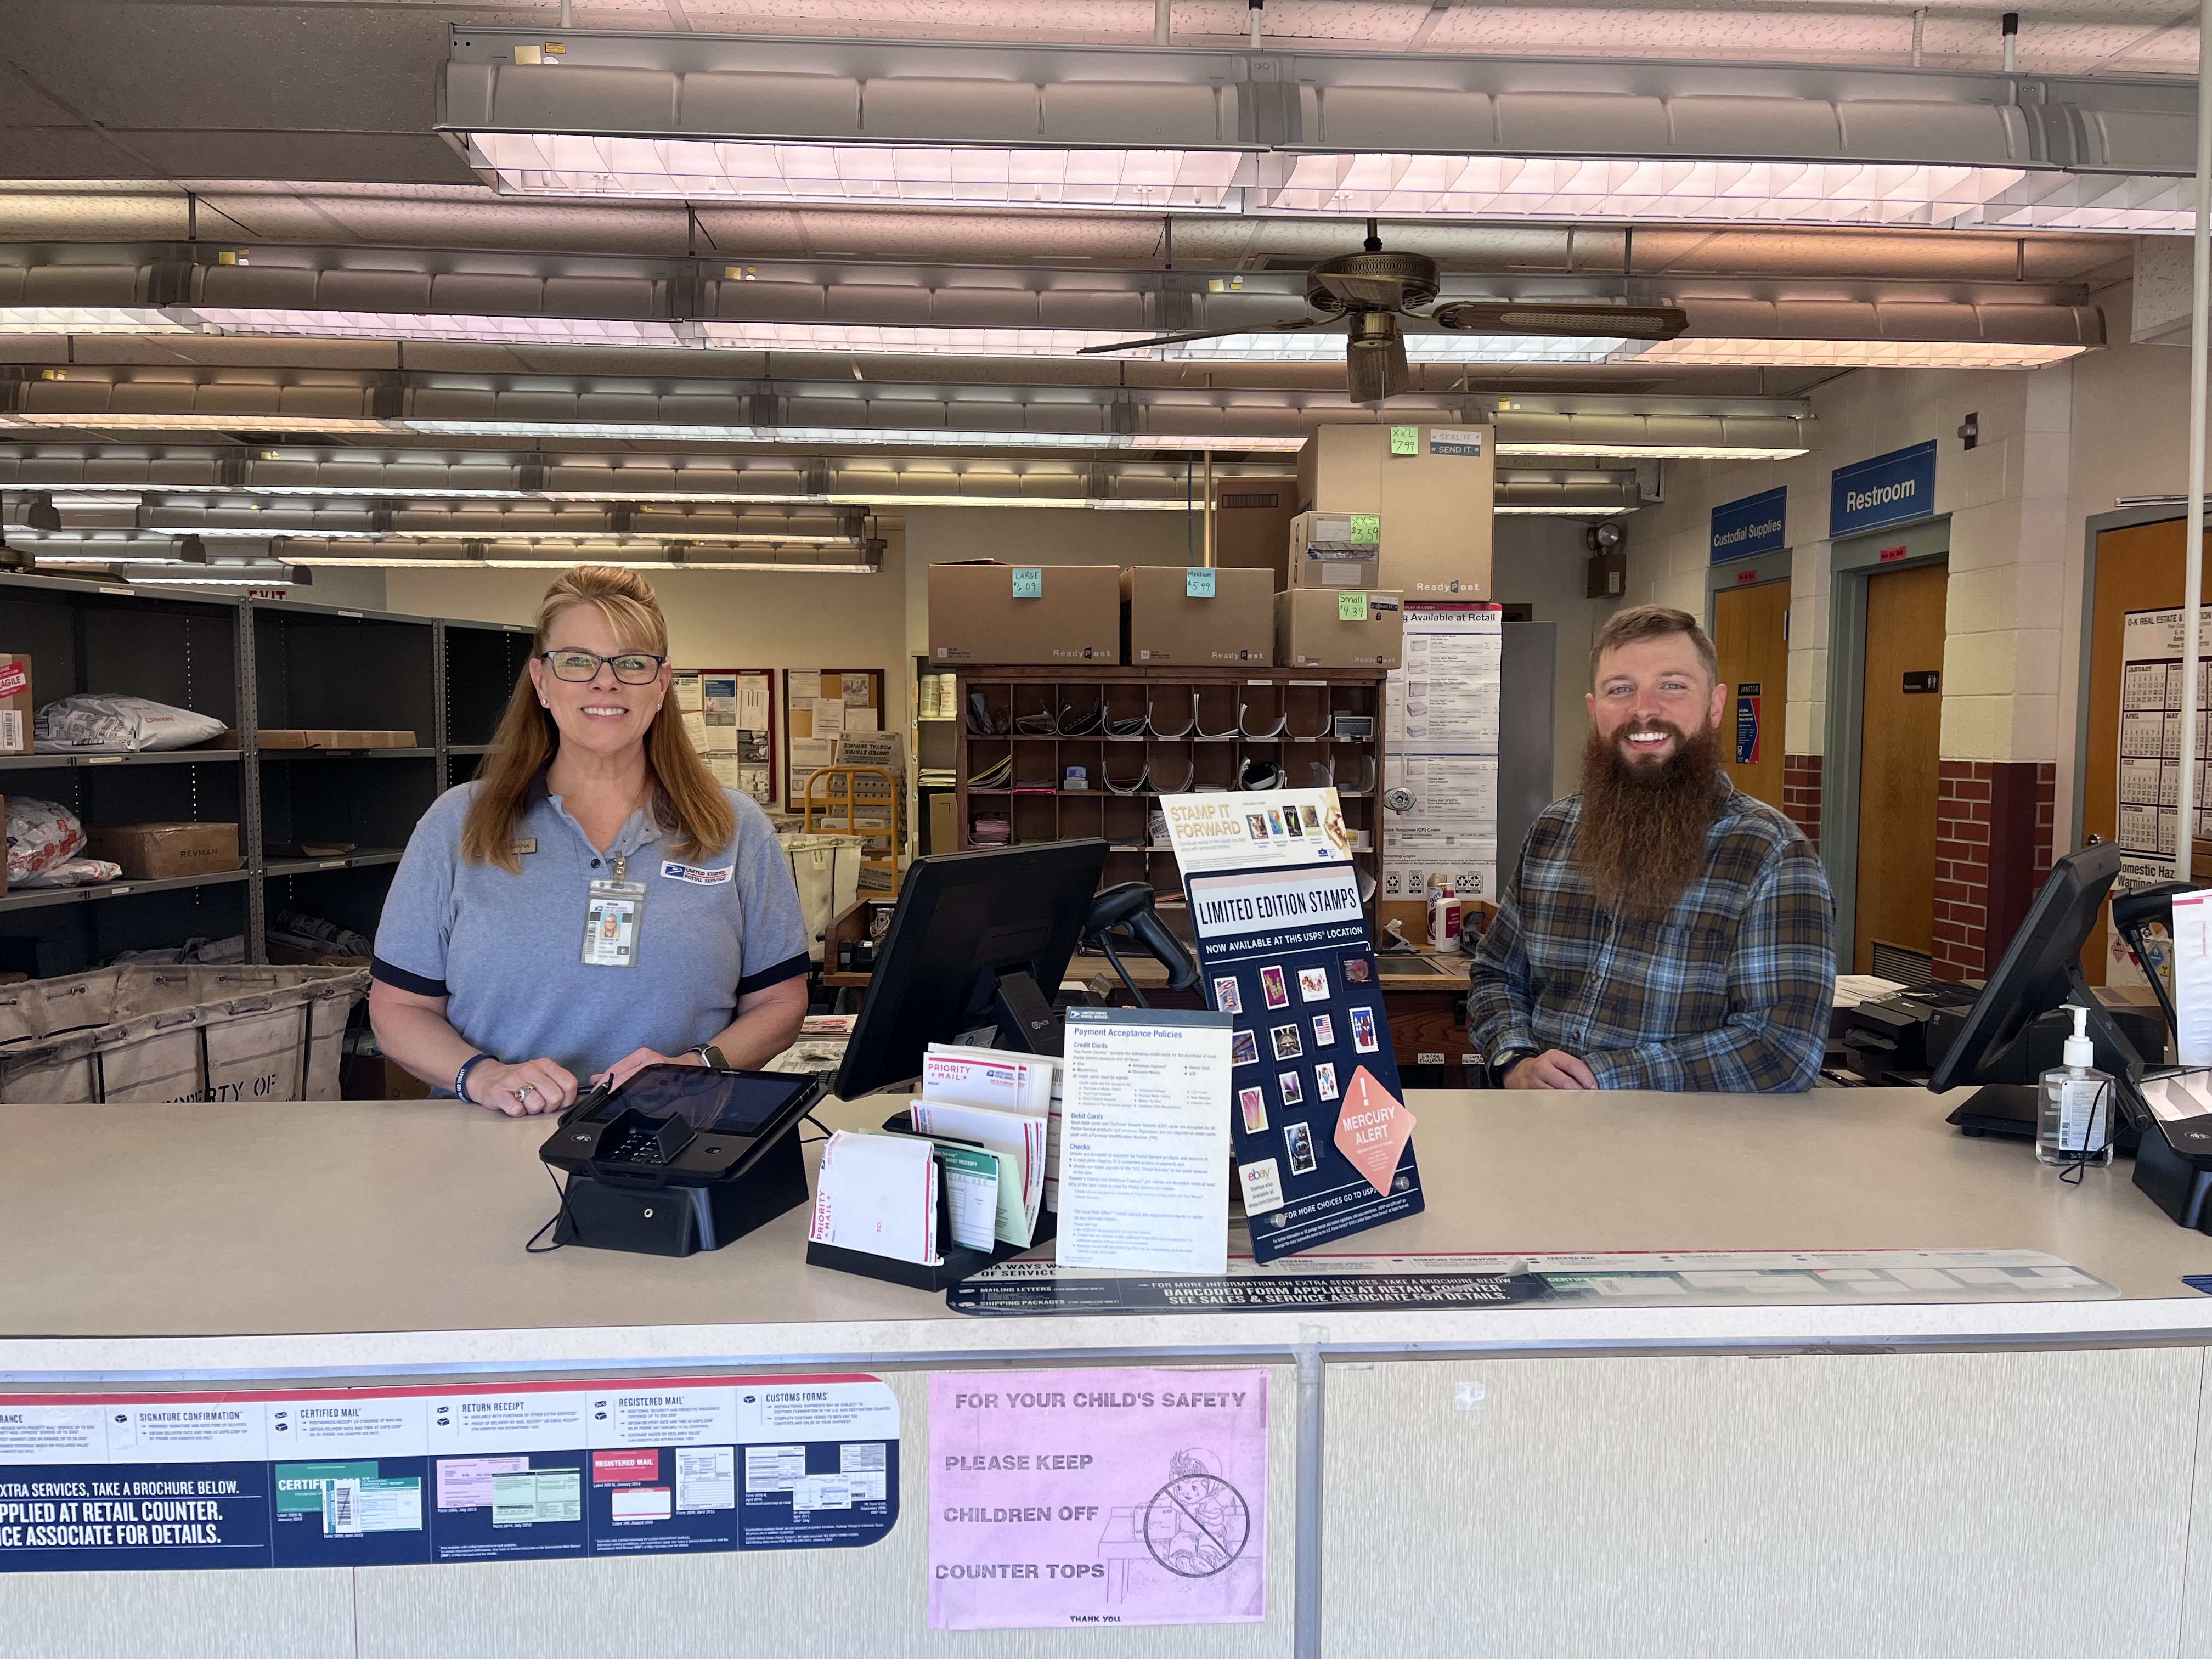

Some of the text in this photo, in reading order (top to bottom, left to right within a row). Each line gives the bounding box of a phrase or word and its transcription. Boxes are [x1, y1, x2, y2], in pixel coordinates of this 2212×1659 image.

[1392, 429, 1415, 438] XXL
[1846, 479, 1915, 513] Restroom
[1352, 516, 1377, 526] XXS
[1351, 526, 1378, 541] $3.59
[1713, 519, 1782, 548] Custodial Supplies
[1417, 580, 1481, 594] ReadyPost
[1340, 594, 1362, 603] Small
[1411, 613, 1453, 622] Available
[1468, 613, 1496, 622] Retail
[2157, 614, 2177, 623] ESTATE
[1053, 647, 1111, 659] ReadyPost
[1211, 649, 1265, 661] ReadyPost
[1355, 655, 1396, 664] ReadyPost
[0, 676, 21, 689] AGILE
[1170, 804, 1229, 821] STAMP IT
[1174, 821, 1241, 838] FORWARD
[180, 849, 218, 858] REVMAN
[685, 867, 705, 876] UNITED
[2121, 864, 2175, 879] omestic Haz
[1198, 888, 1356, 925] LIMITED EDITION STAMPS
[1206, 943, 1227, 955] NOW
[1229, 937, 1272, 951] AVAILABLE
[1274, 936, 1283, 946] AT
[1285, 933, 1302, 944] THIS
[1327, 926, 1363, 939] LOCATION
[1039, 1019, 1051, 1028] NCR
[1075, 1028, 1182, 1039] Payment Acceptance Policies
[928, 1064, 971, 1074] PRIORITY
[1342, 1105, 1396, 1132] MERCURY
[1356, 1125, 1388, 1146] ALERT
[1248, 1168, 1271, 1182] ebay
[1248, 1195, 1281, 1209] ebay.com/stamps
[1252, 1191, 1269, 1199] available
[1284, 1187, 1379, 1220] FOR MORE CHOICES GO TO USPS.
[816, 1190, 826, 1240] PRIORITY
[1163, 1288, 1243, 1296] BARCODED
[1293, 1286, 1355, 1294] APPLIED
[1358, 1286, 1375, 1294] AT
[1379, 1285, 1428, 1294] RETAIL
[1431, 1284, 1506, 1293] COUNTER.
[1169, 1296, 1197, 1305] SEE
[1200, 1295, 1246, 1304] SALES
[1266, 1294, 1329, 1303] SERVICE
[1331, 1293, 1413, 1302] ASSOCIATE
[1414, 1293, 1443, 1301] FOR
[1444, 1291, 1510, 1301] DETAILS.
[462, 1402, 524, 1413] RETURN RECEIPT
[955, 1391, 1247, 1410] FOR YOUR CHILD'S SAFETY
[300, 1409, 339, 1418] CERTIFIED
[945, 1454, 1094, 1471] PLEASE KEEP
[0, 1480, 240, 1498] XTRA SERVICES, TAKE A BROCHURE BELOW.
[0, 1500, 223, 1523] PPLIED AT RETAIL COUNTER.
[943, 1505, 1099, 1524] CHILDREN OFF
[26, 1524, 113, 1547] ASSOCIATE
[116, 1523, 148, 1545] FOR
[151, 1523, 221, 1544] DETAILS.
[936, 1564, 1105, 1581] COUNTER TOPS
[1069, 1615, 1121, 1624] THANK YOU
